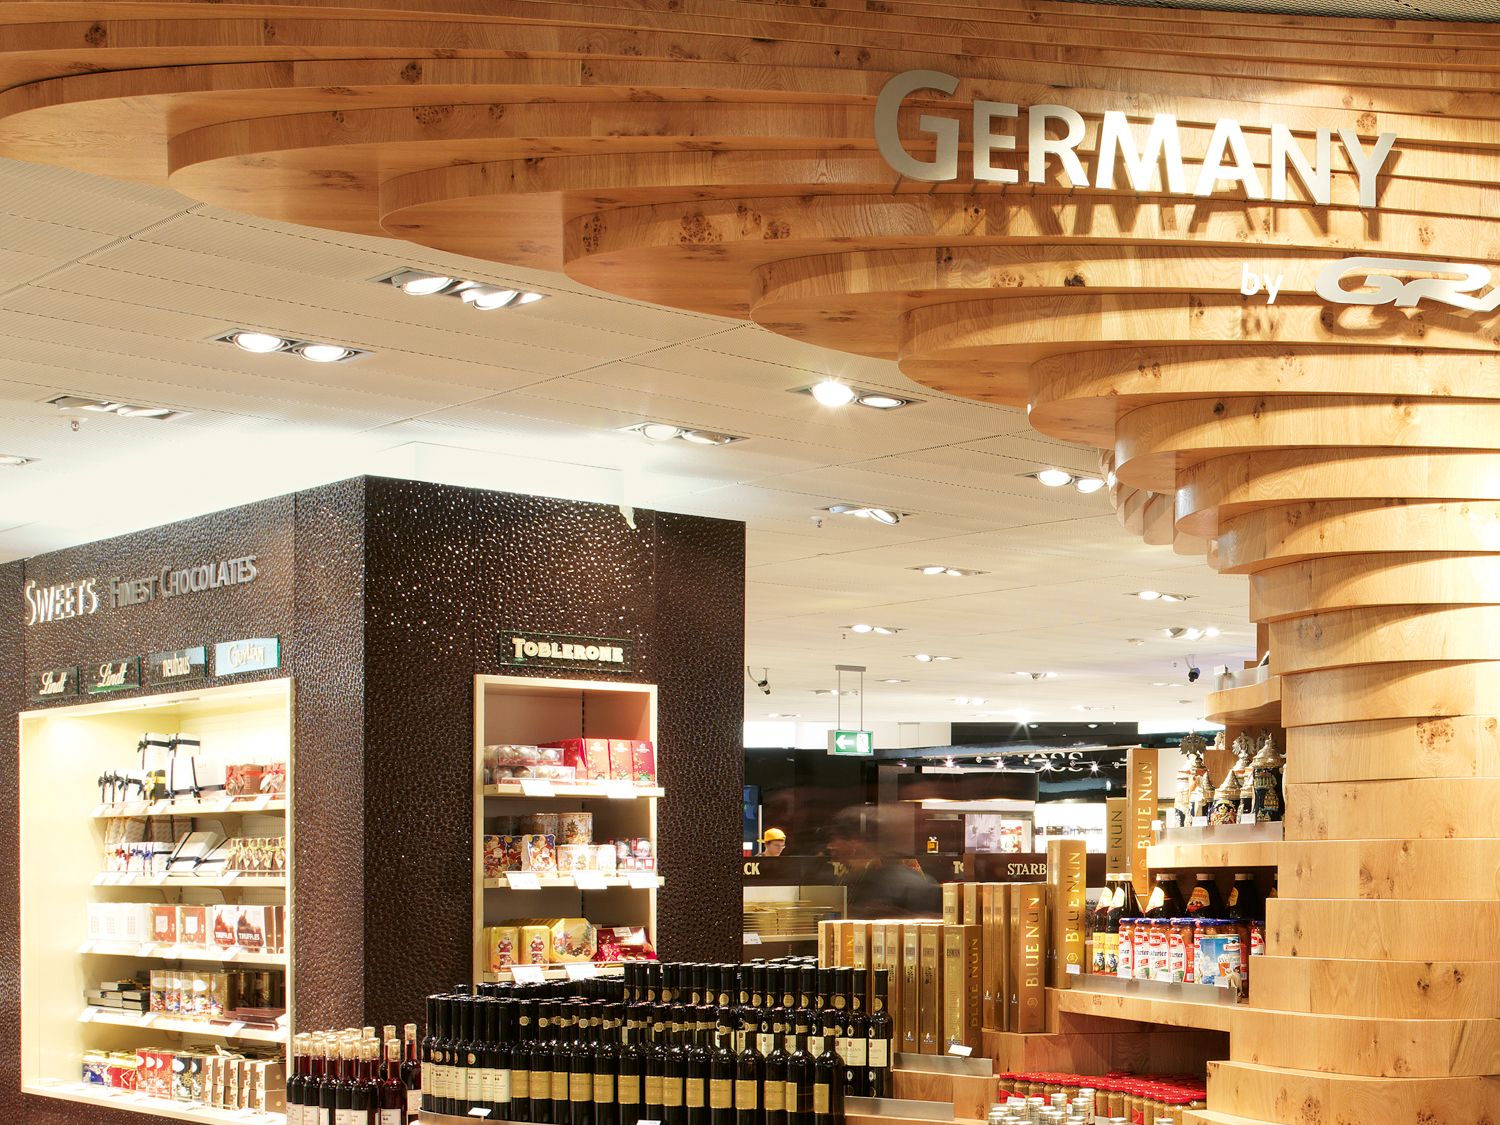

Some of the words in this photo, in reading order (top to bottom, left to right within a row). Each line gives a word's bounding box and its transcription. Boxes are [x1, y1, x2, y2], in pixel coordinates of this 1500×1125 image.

[873, 69, 1397, 208] GERMANY
[1240, 262, 1284, 305] by
[25, 578, 98, 626] SWEETS
[109, 576, 158, 609] FINEST
[160, 555, 258, 599] CHOCOLATES
[511, 637, 624, 663] TOBLERONE
[97, 661, 128, 687] Lindt
[1007, 861, 1047, 876] STARB
